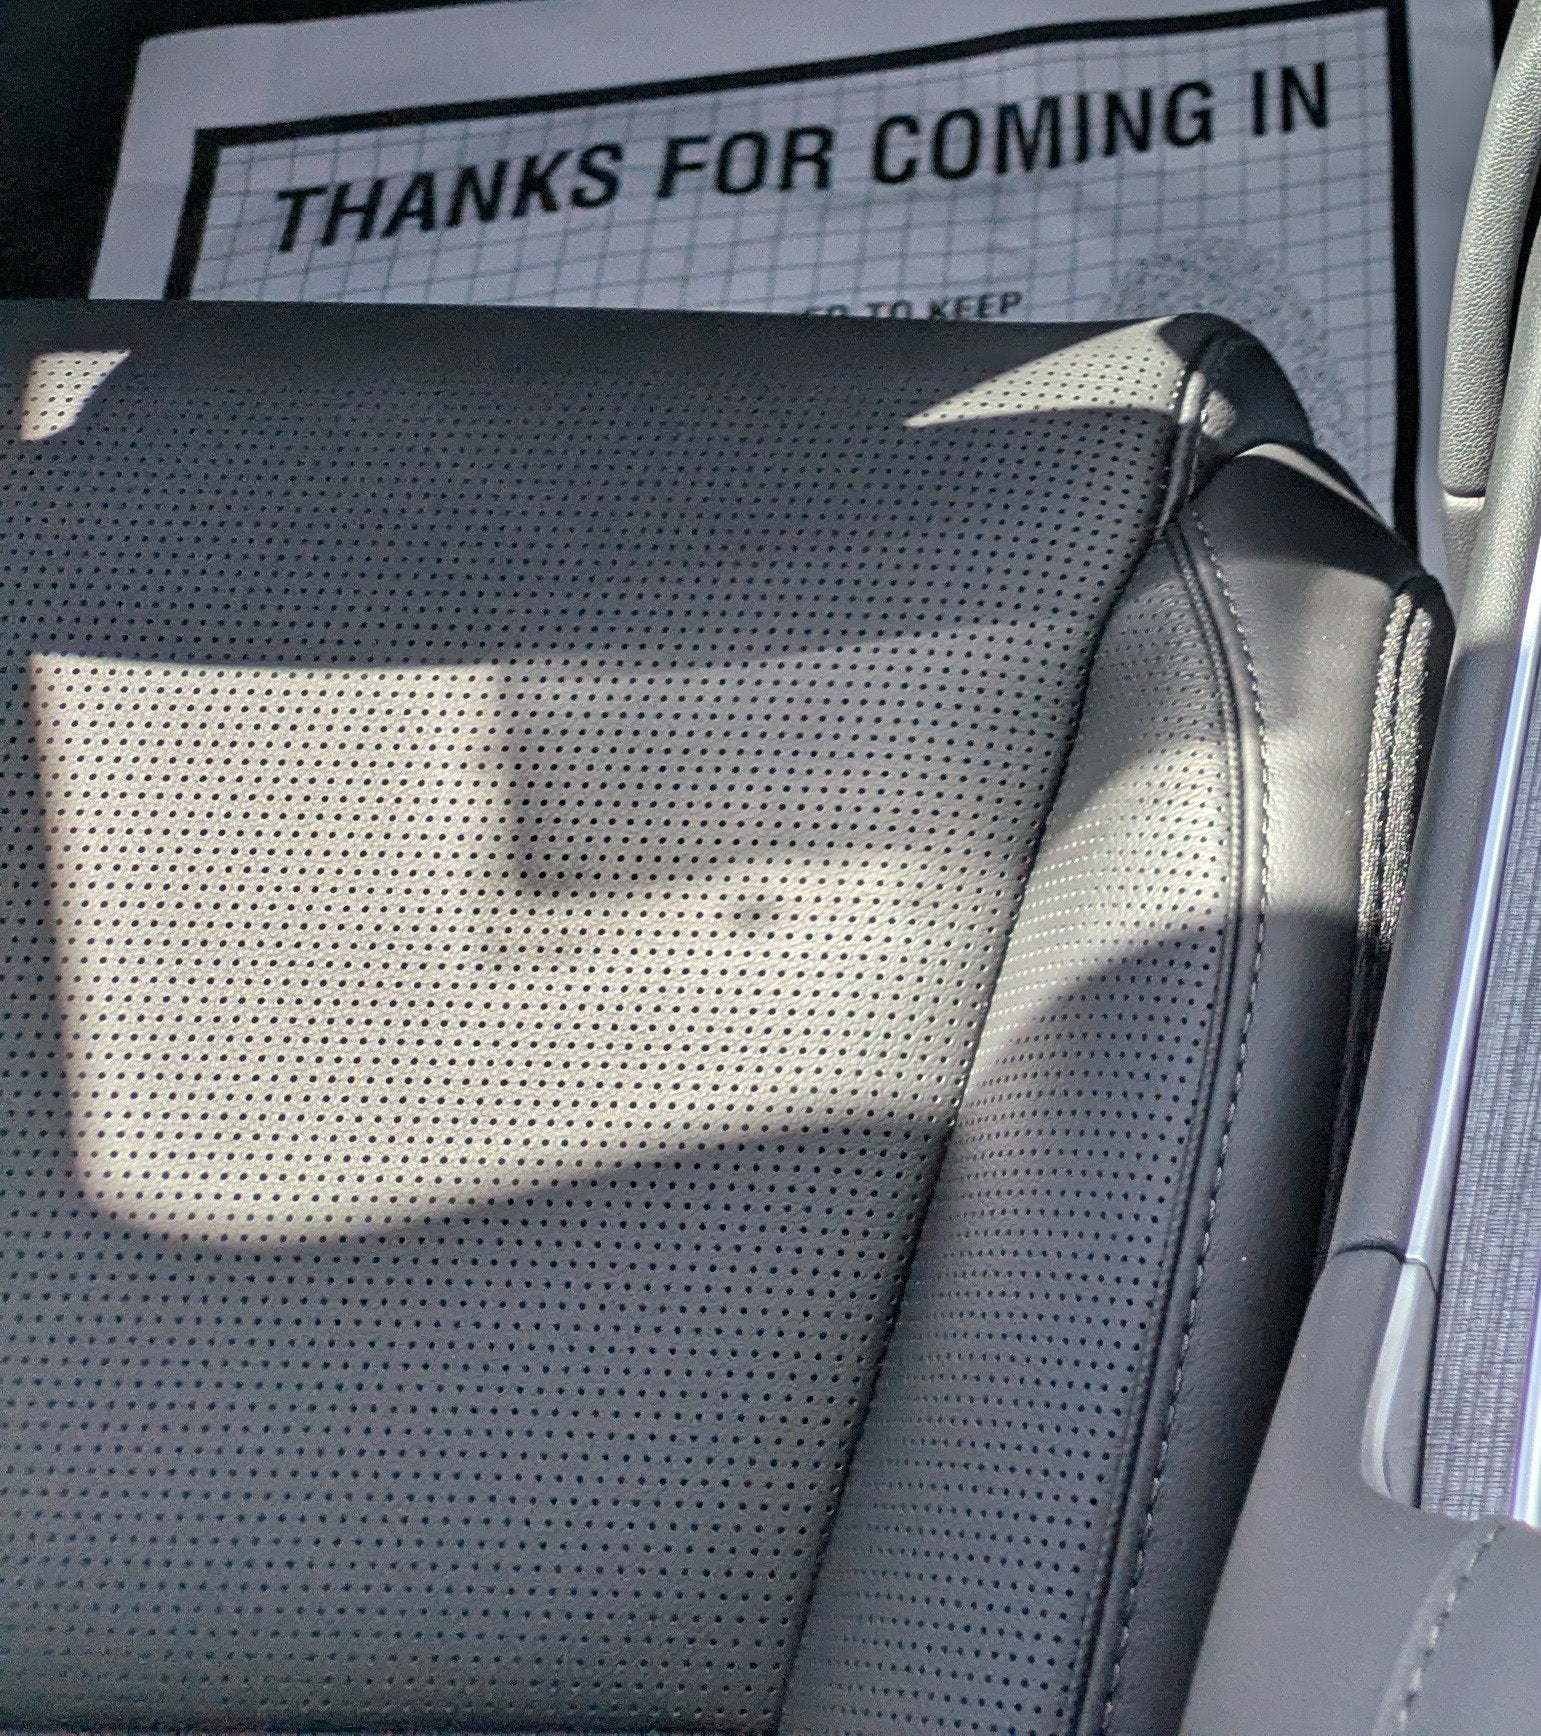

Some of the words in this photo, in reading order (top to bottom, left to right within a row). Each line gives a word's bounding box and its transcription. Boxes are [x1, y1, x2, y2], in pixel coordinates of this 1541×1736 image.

[276, 142, 624, 254] THANKS
[656, 124, 836, 200] FOR
[870, 79, 1214, 186] COMING
[1250, 62, 1328, 137] IN
[929, 290, 1024, 322] KEEP
